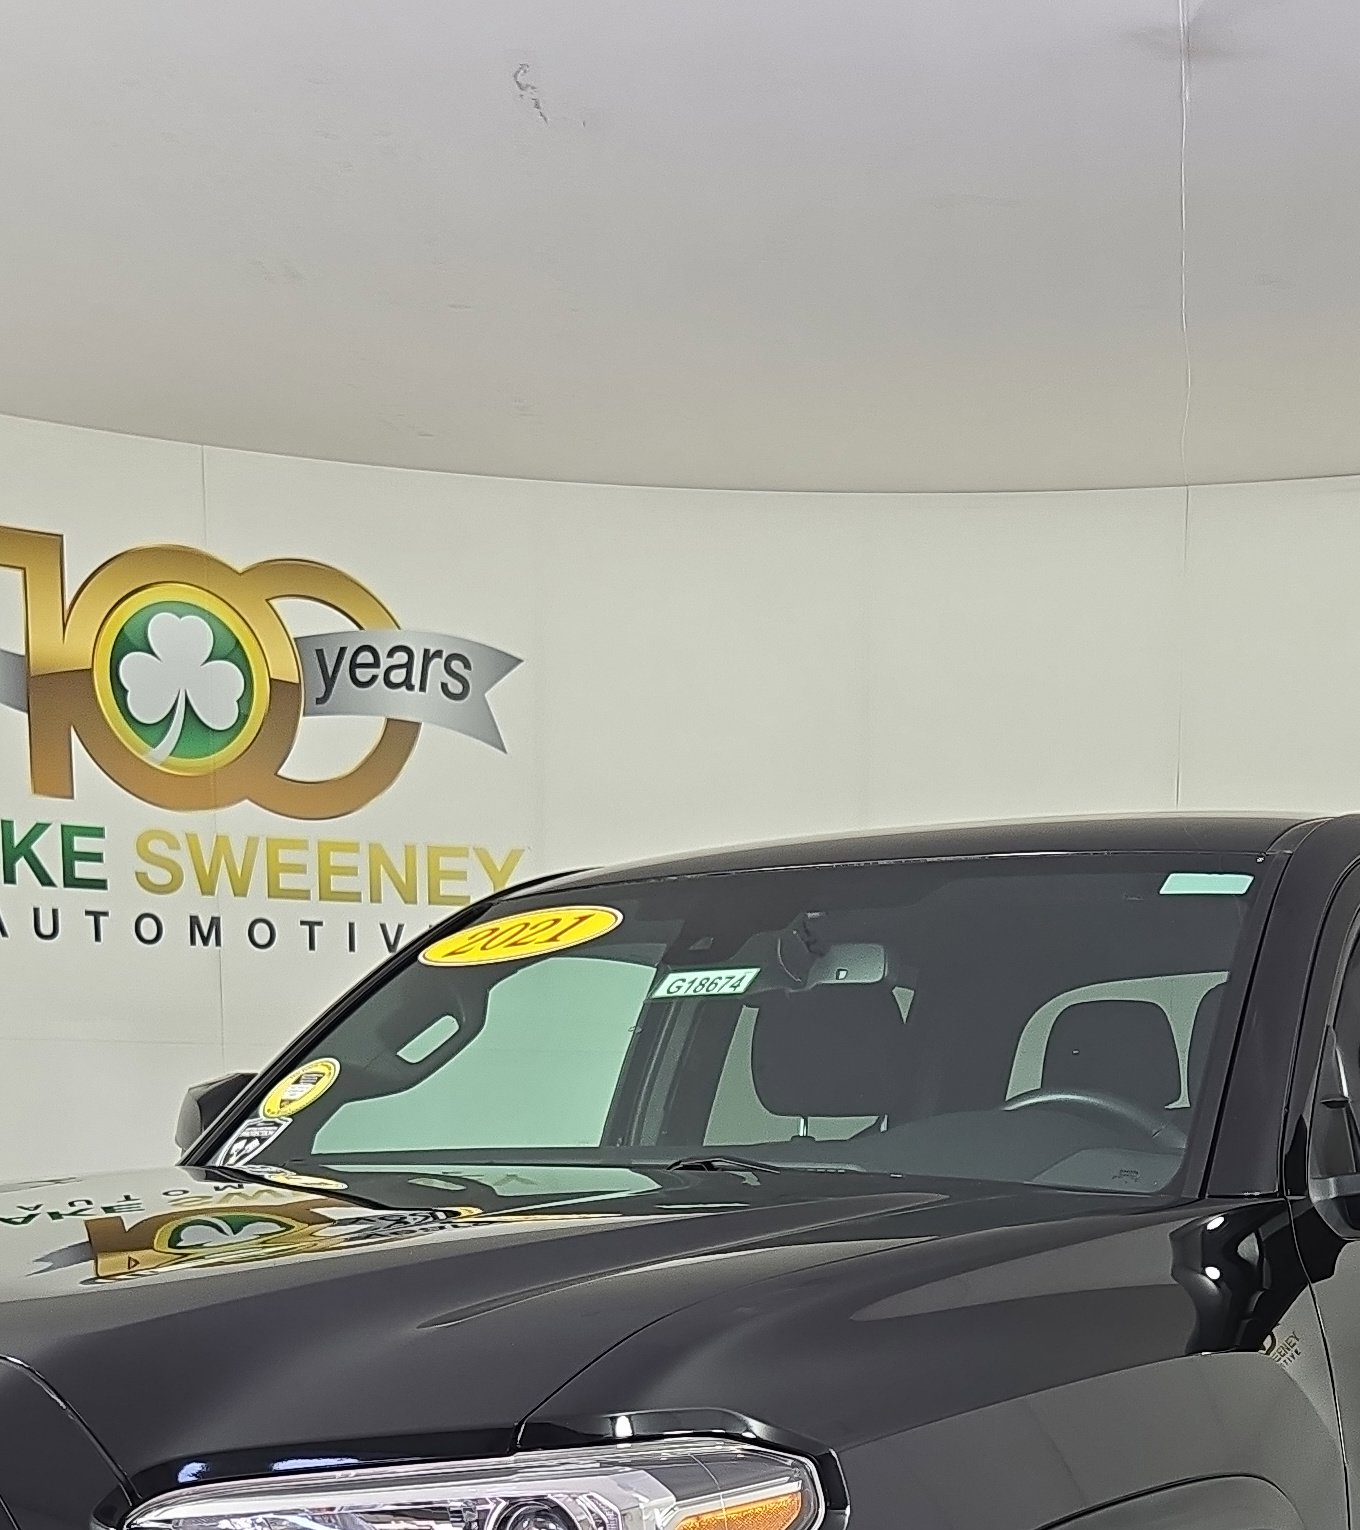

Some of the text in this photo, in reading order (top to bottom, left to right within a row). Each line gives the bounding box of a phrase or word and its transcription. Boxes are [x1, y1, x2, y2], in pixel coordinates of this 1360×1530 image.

[315, 643, 474, 705] years
[134, 828, 526, 907] SWEENEY
[441, 912, 597, 958] 2021
[665, 973, 745, 996] G18674
